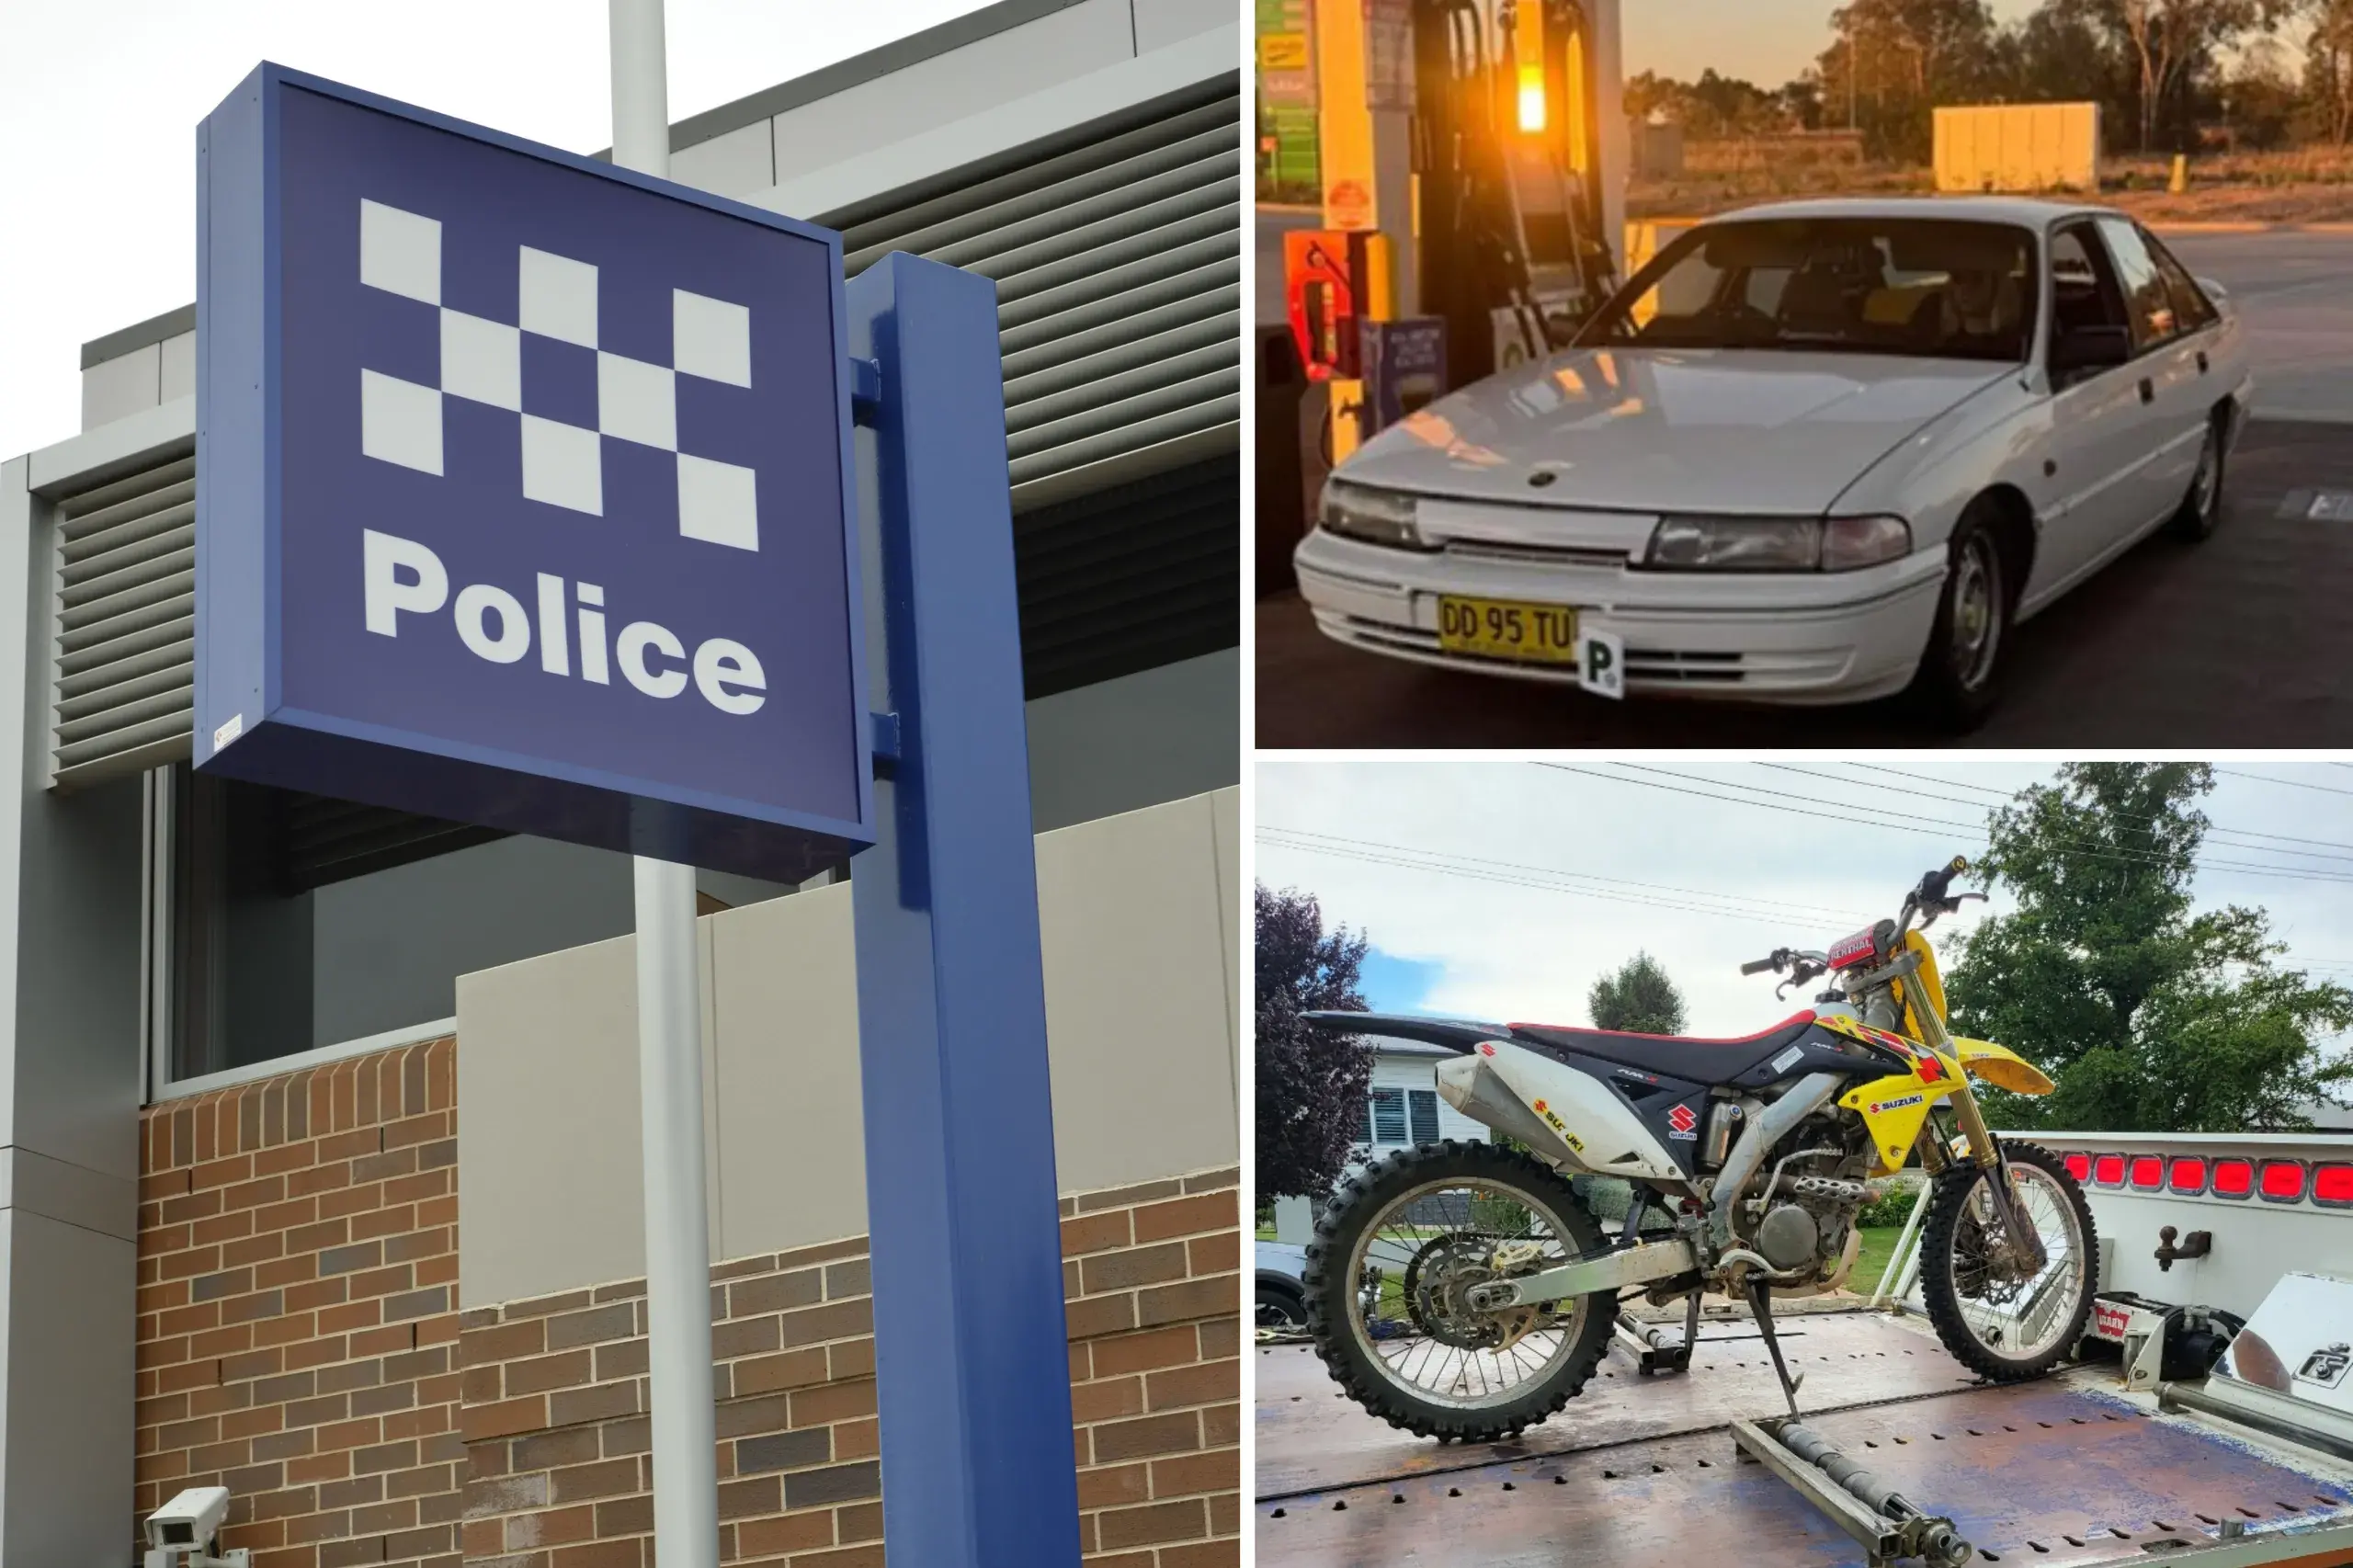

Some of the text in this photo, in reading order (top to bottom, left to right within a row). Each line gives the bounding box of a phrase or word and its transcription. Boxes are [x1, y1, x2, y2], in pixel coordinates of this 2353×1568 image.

[364, 528, 767, 715] Police
[1442, 603, 1571, 649] DD 95 TU
[1587, 640, 1613, 684] P
[1881, 1095, 1923, 1109] SUZUKI
